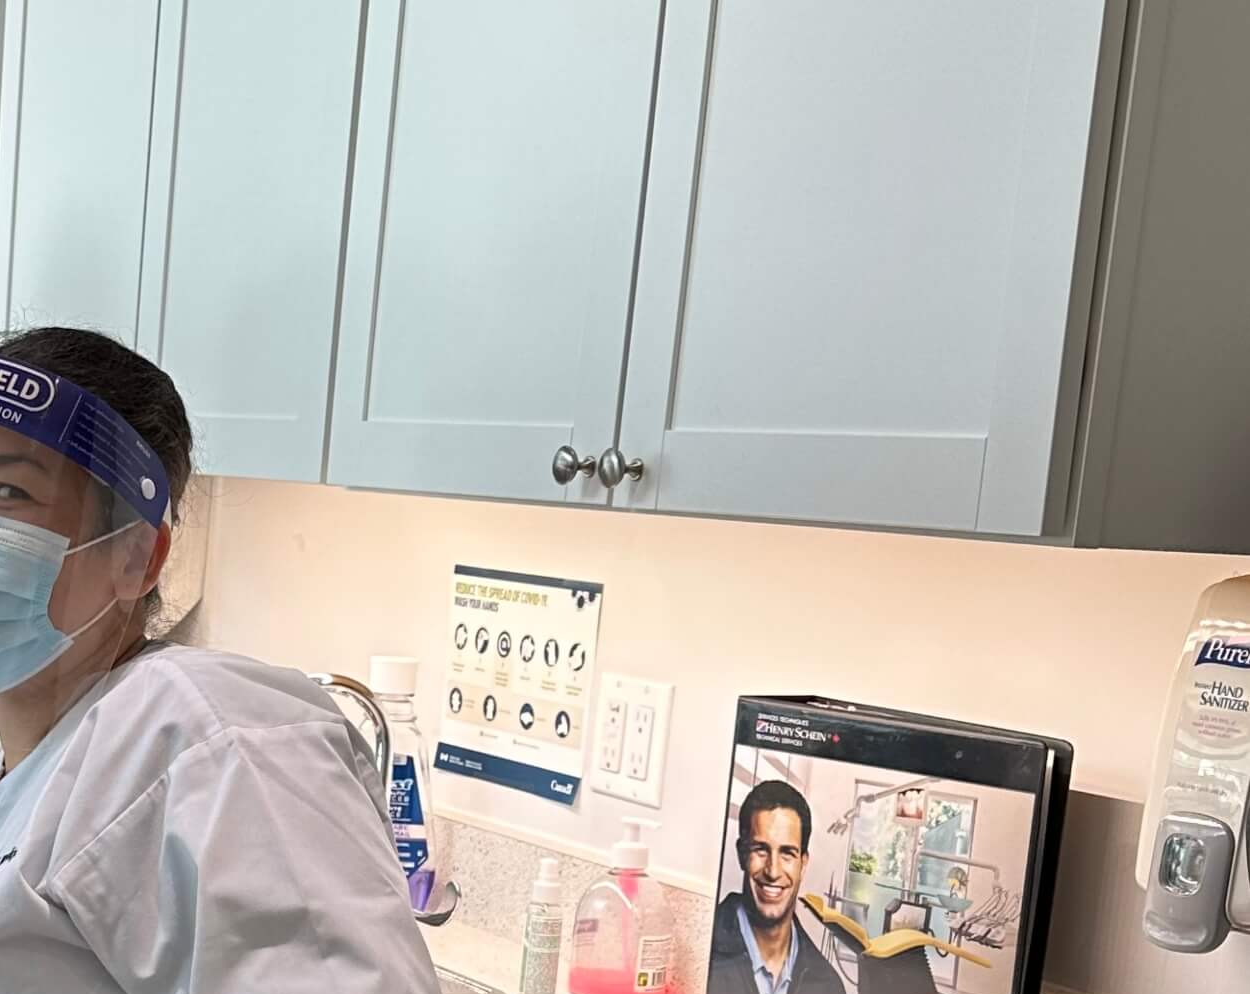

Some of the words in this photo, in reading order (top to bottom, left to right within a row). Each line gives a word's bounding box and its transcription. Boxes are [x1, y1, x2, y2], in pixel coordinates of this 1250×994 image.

[477, 585, 488, 598] THE
[489, 587, 512, 601] SPREAD
[512, 590, 521, 602] OF
[1211, 680, 1244, 699] HAND
[1200, 691, 1250, 712] SANITIZER
[765, 722, 795, 737] HENRY
[795, 726, 826, 742] SCHEIN
